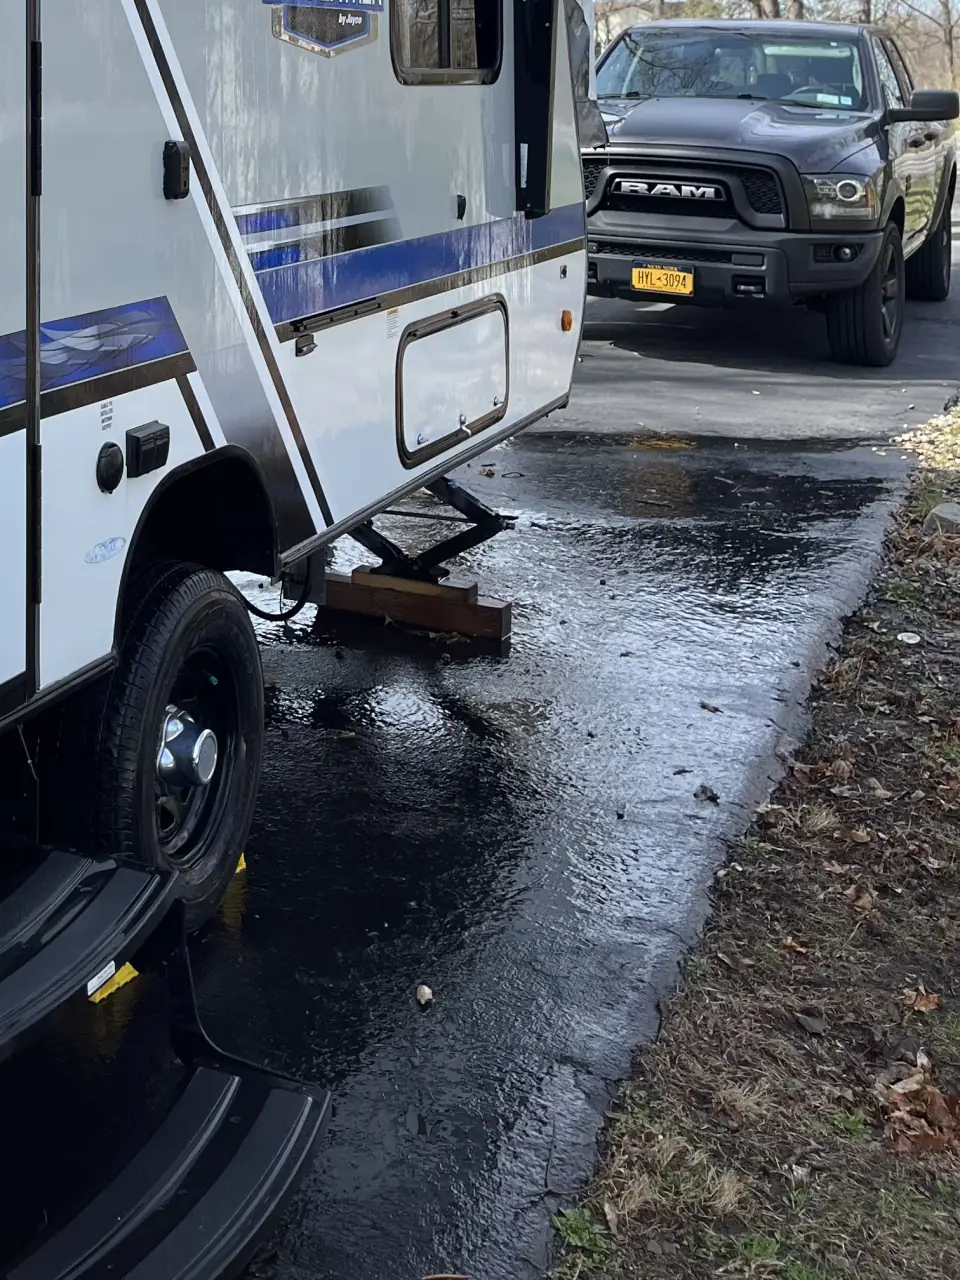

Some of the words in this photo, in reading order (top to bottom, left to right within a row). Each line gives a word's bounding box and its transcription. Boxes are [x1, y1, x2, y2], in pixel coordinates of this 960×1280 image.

[338, 13, 347, 26] by
[346, 14, 362, 26] Jayco
[621, 181, 716, 199] RAM
[638, 270, 656, 286] HYL
[662, 273, 687, 289] 3094
